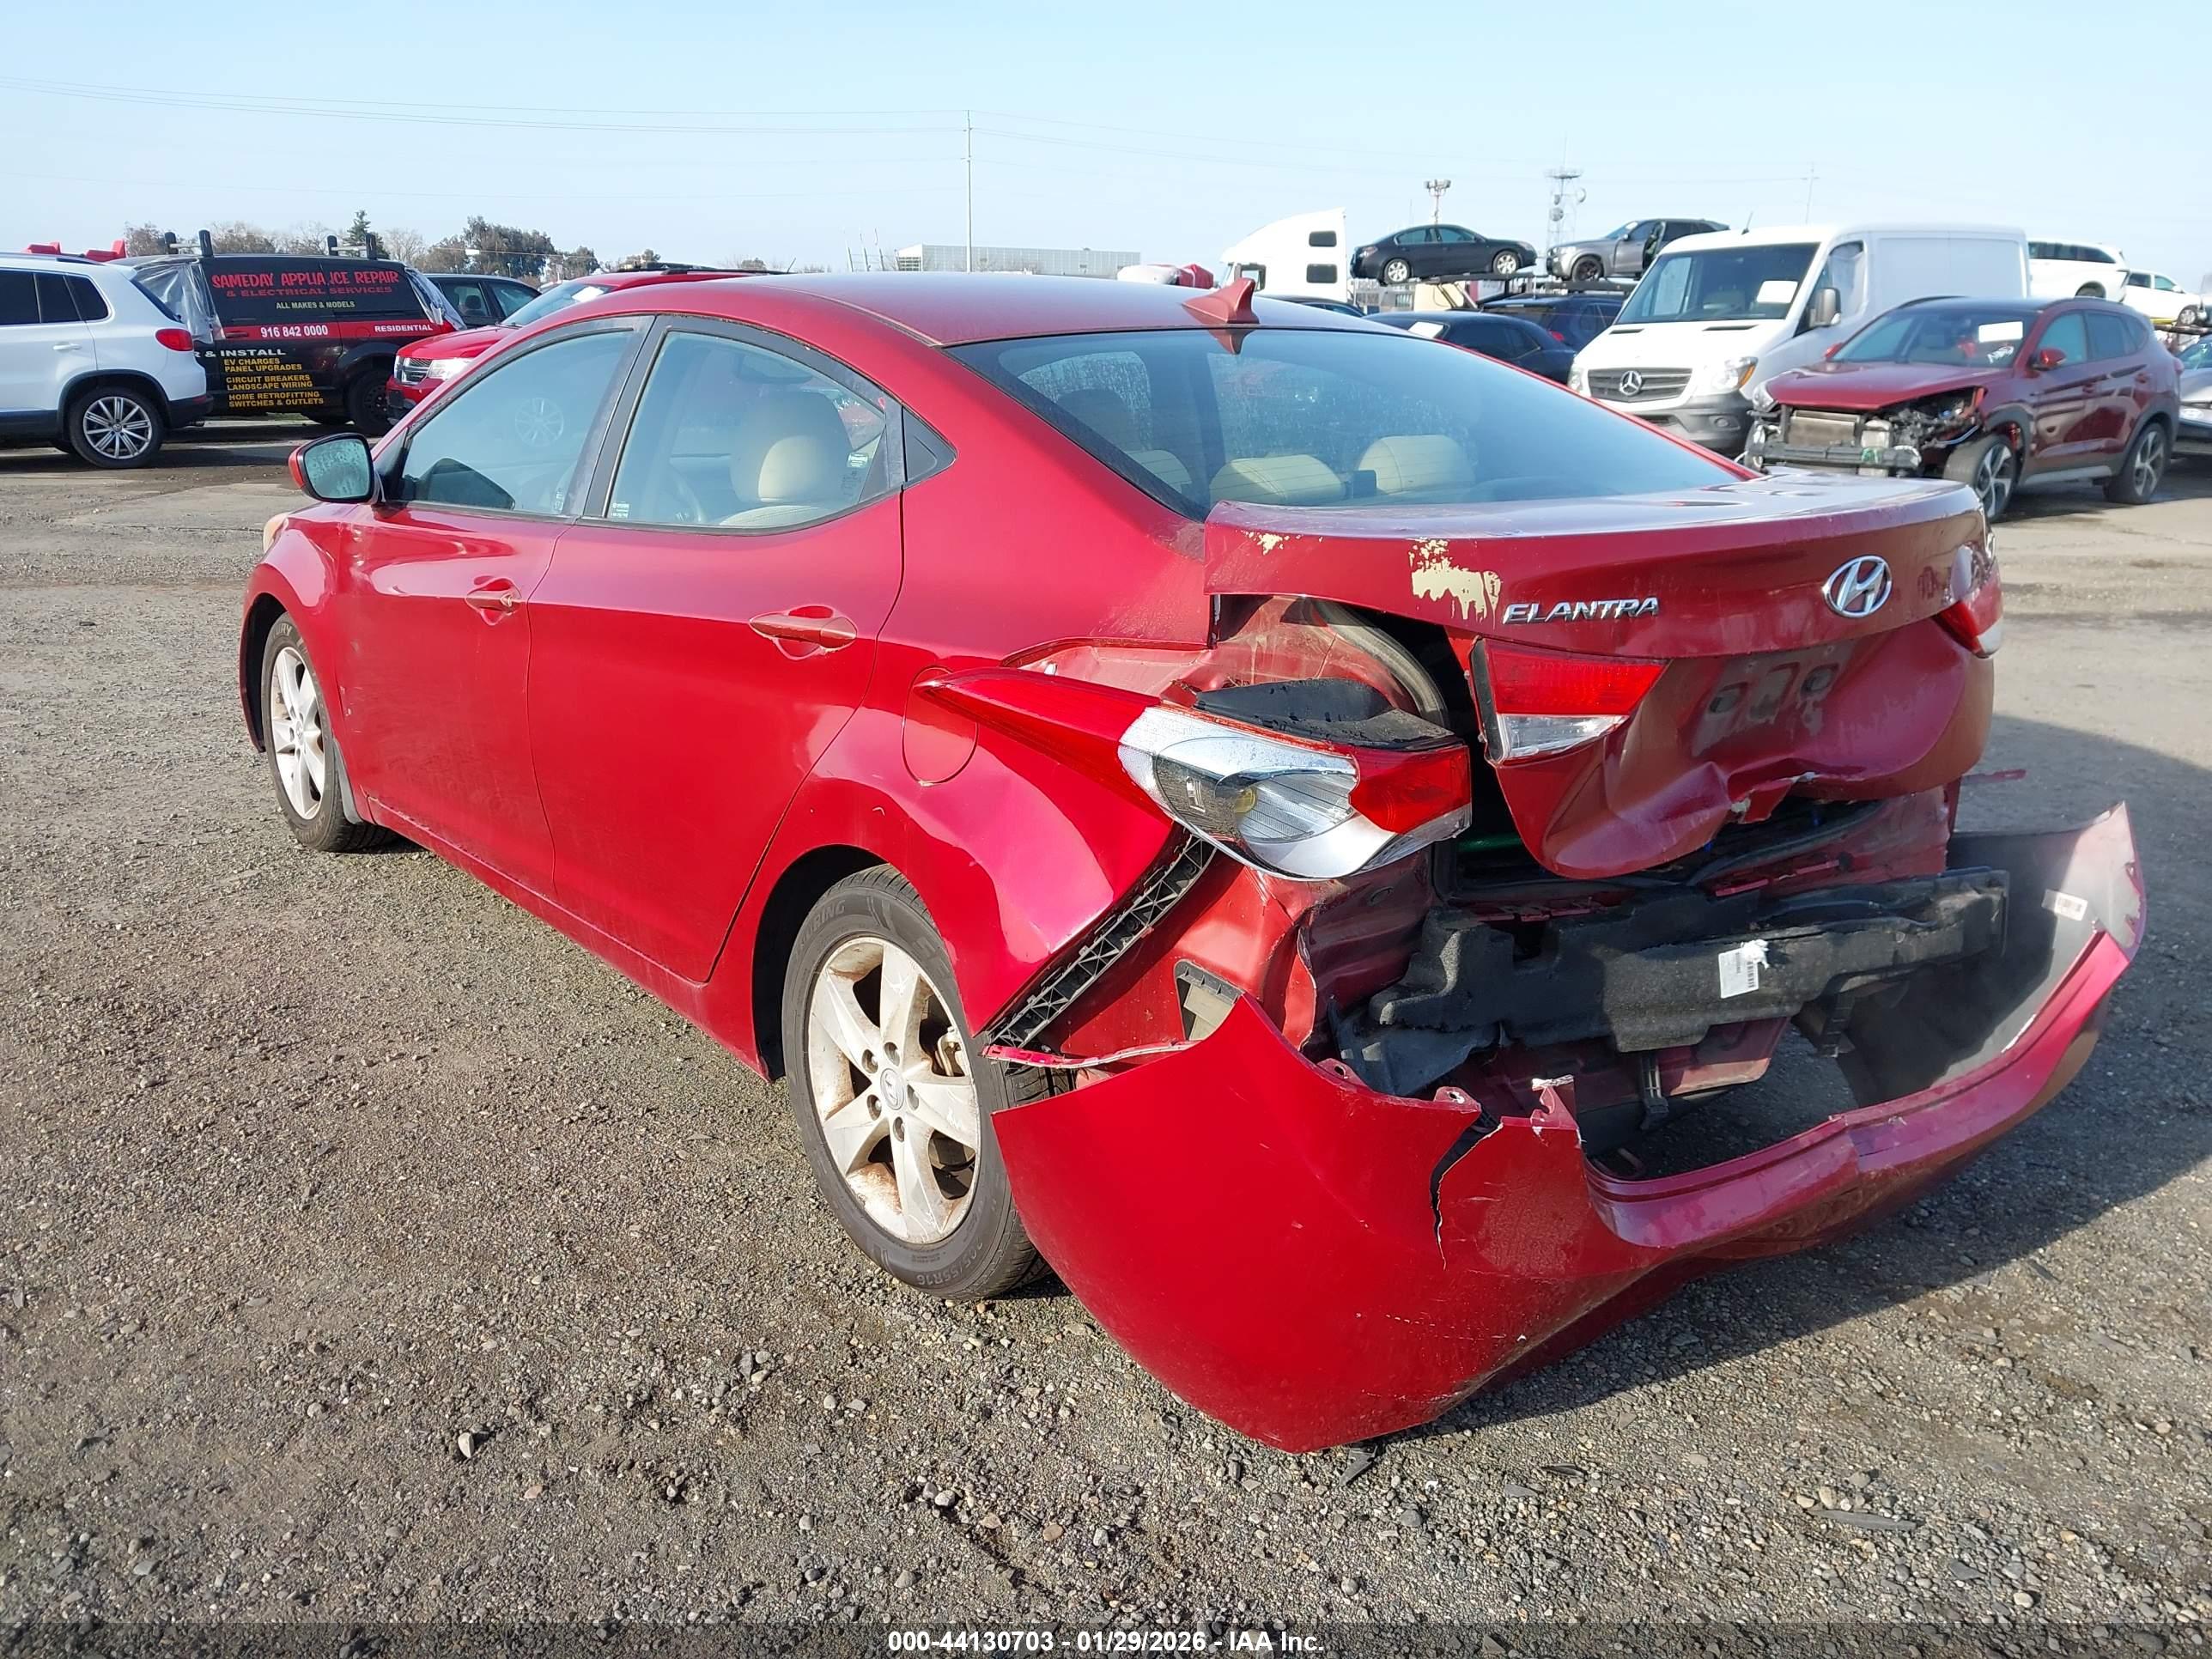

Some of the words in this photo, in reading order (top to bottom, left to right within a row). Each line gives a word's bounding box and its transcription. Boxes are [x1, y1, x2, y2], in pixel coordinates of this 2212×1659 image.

[212, 273, 274, 288] SAMEDAY
[355, 271, 398, 283] REPAIR
[240, 288, 325, 296] ELECTRICAL
[261, 327, 280, 337] 916
[283, 325, 301, 337] 842
[304, 325, 327, 336] 0000
[374, 324, 433, 332] RESIDENTIAL
[226, 375, 262, 384] CIRCUIT
[228, 392, 255, 401] HOME
[229, 399, 275, 408] SWITCHES
[1503, 597, 1659, 625] ELANTRA
